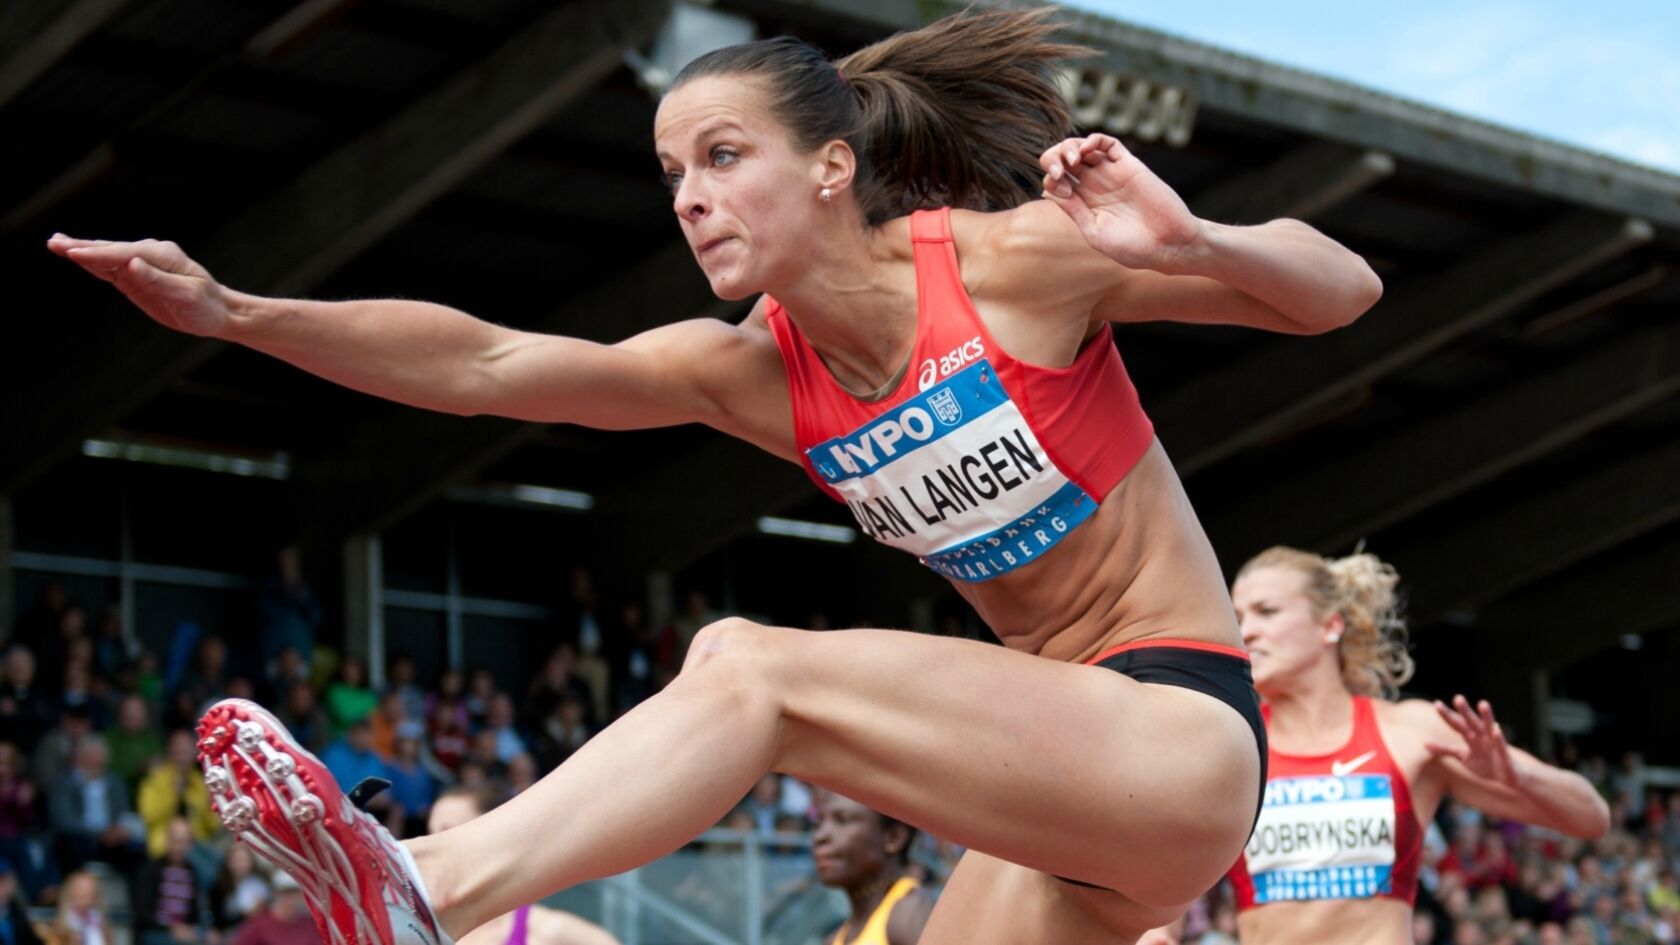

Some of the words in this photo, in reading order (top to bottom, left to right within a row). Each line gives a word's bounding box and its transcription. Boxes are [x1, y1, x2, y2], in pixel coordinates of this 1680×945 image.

[939, 335, 985, 377] asics
[828, 407, 935, 474] HYPO
[847, 495, 917, 540] VAN
[899, 428, 1045, 526] LANGEN
[1264, 777, 1345, 807] HYPO
[1249, 818, 1392, 857] DOBRYNSKA
